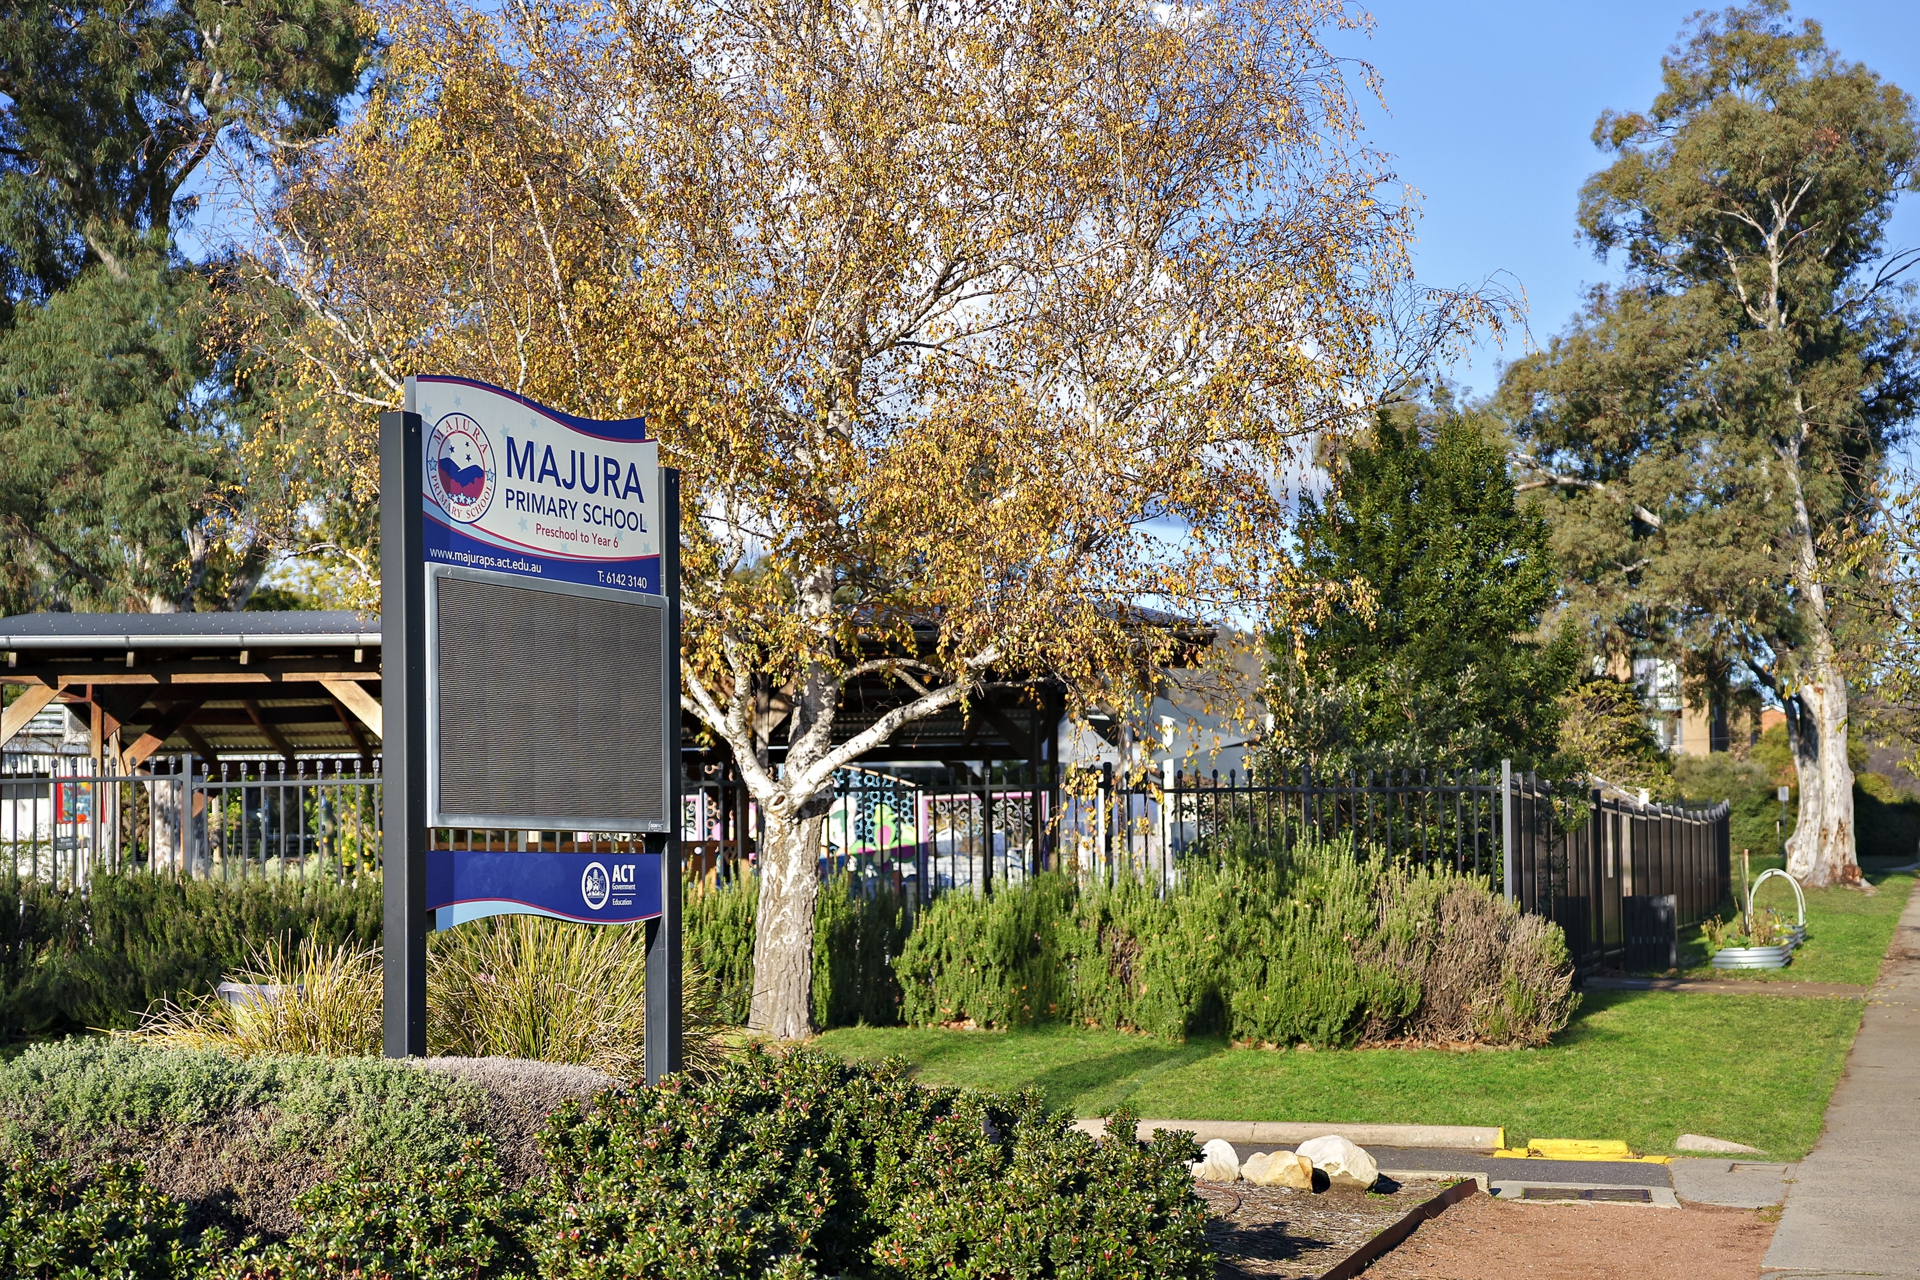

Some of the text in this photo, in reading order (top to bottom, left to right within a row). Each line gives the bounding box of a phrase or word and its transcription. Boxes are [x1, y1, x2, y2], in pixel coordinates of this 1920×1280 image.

[433, 417, 489, 454] MAJURA
[506, 435, 645, 504] MAJURA
[431, 474, 493, 519] PRIMARY SCHOOL
[505, 488, 647, 534] PRIMARY SCHOOL
[535, 522, 619, 549] Preschool to Year 6
[429, 547, 542, 574] www.majuraps.act.edu.au
[597, 570, 648, 589] T: 6142 3140
[612, 864, 636, 882] ACT
